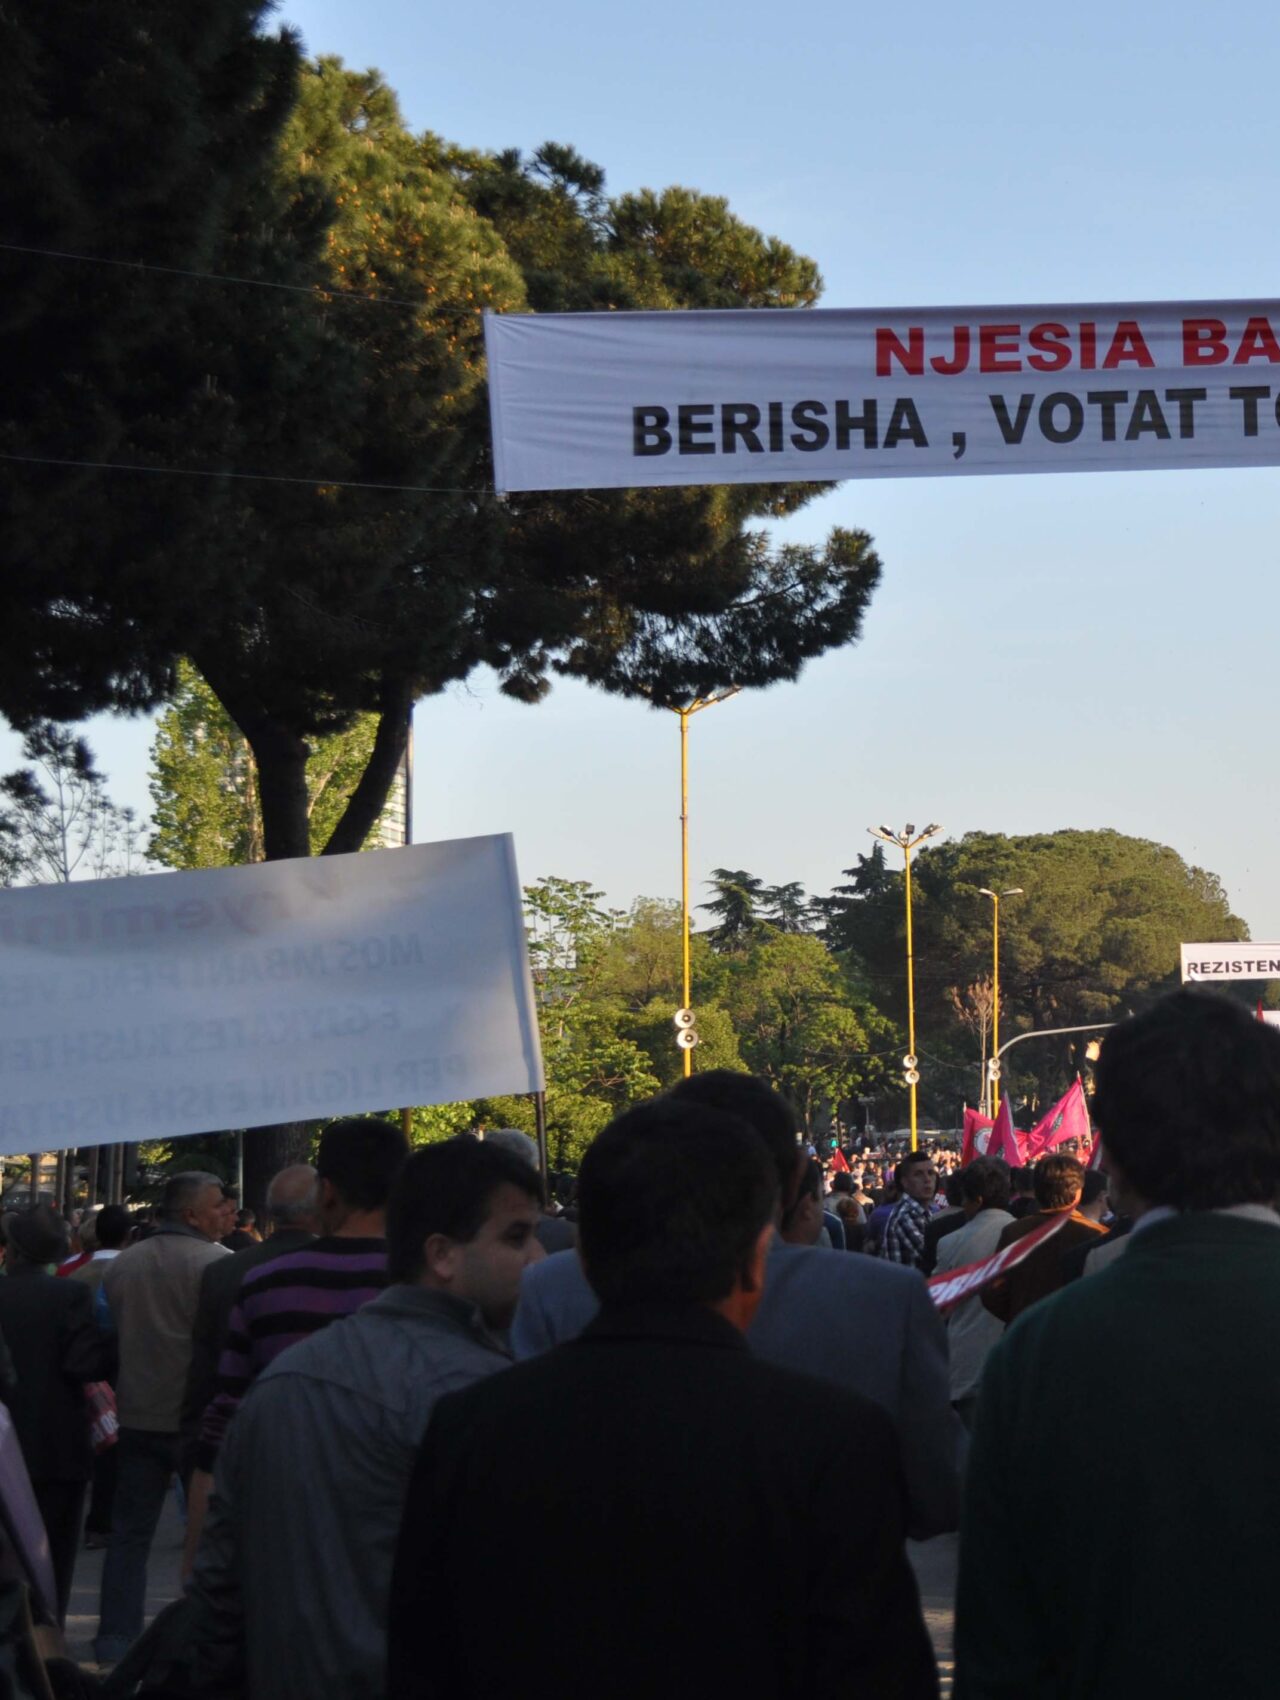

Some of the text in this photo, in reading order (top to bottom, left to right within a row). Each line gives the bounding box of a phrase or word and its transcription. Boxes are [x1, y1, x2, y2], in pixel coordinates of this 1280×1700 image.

[874, 321, 1156, 378] NJESIA
[632, 398, 929, 457] BERISHA
[989, 387, 1207, 445] VOTAT
